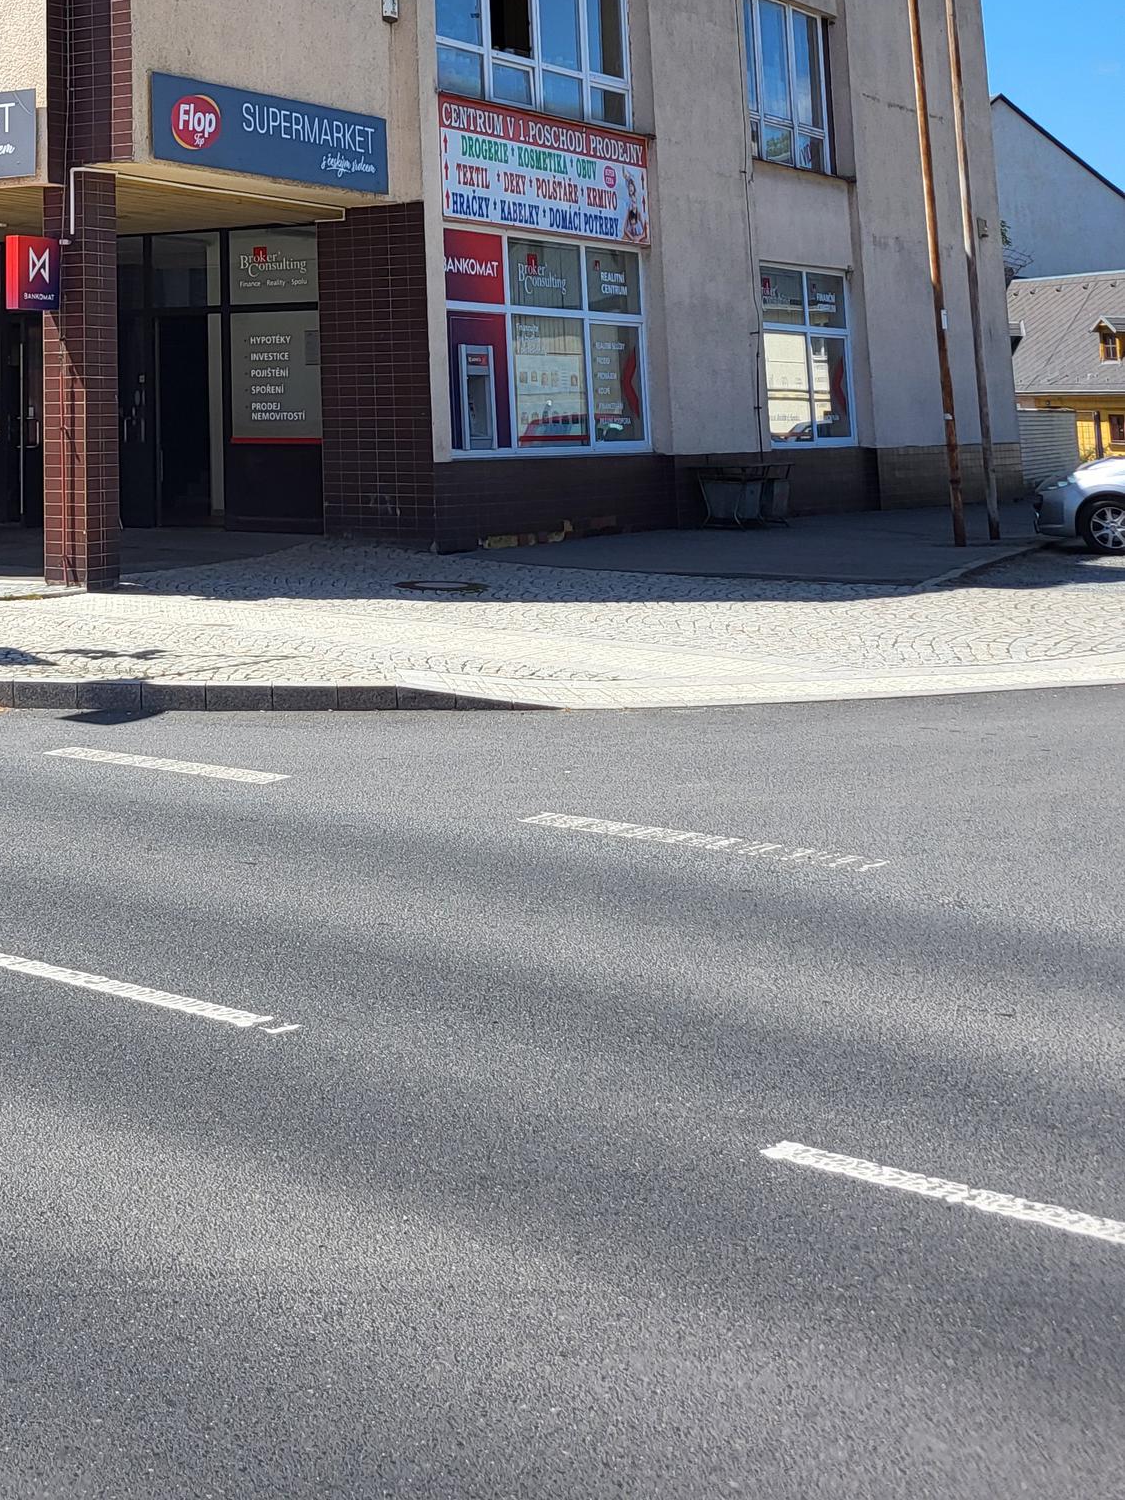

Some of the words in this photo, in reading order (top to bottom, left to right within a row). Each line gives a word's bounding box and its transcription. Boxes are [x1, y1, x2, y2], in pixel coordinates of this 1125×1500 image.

[179, 103, 216, 137] Flop
[242, 102, 375, 154] SUPERMARKET
[442, 102, 504, 137] CENTRUM
[507, 116, 515, 139] V
[590, 134, 643, 165] PRODEJNY
[461, 134, 508, 164] DROGERIE
[517, 145, 568, 175] KOSMETIKA
[576, 158, 596, 180] OBUV
[456, 163, 490, 189] TEXTIL
[504, 171, 526, 195] DEKY
[587, 186, 618, 211] KRMIVO
[452, 190, 490, 218] HRAČKY
[500, 199, 539, 225] KABELKY
[549, 205, 581, 232] DOMÁCÍ
[584, 210, 619, 237] POTŘEBY
[240, 250, 279, 269] Broker
[248, 259, 307, 277] Consulting
[518, 261, 547, 282] Broker
[240, 280, 261, 288] Finance
[267, 279, 286, 287] Reality
[291, 278, 308, 286] Spolu
[525, 274, 567, 295] Consulting
[24, 293, 55, 301] BANKOMAT
[250, 334, 291, 344] HYPOTÉKY
[250, 352, 289, 361] INVESTICE
[251, 367, 289, 377] POJIŠTĚNÍ
[251, 385, 284, 394] SPOŘENÍ
[251, 402, 281, 411] PRODEJ
[251, 410, 306, 421] NEMOVITOSTÍ
